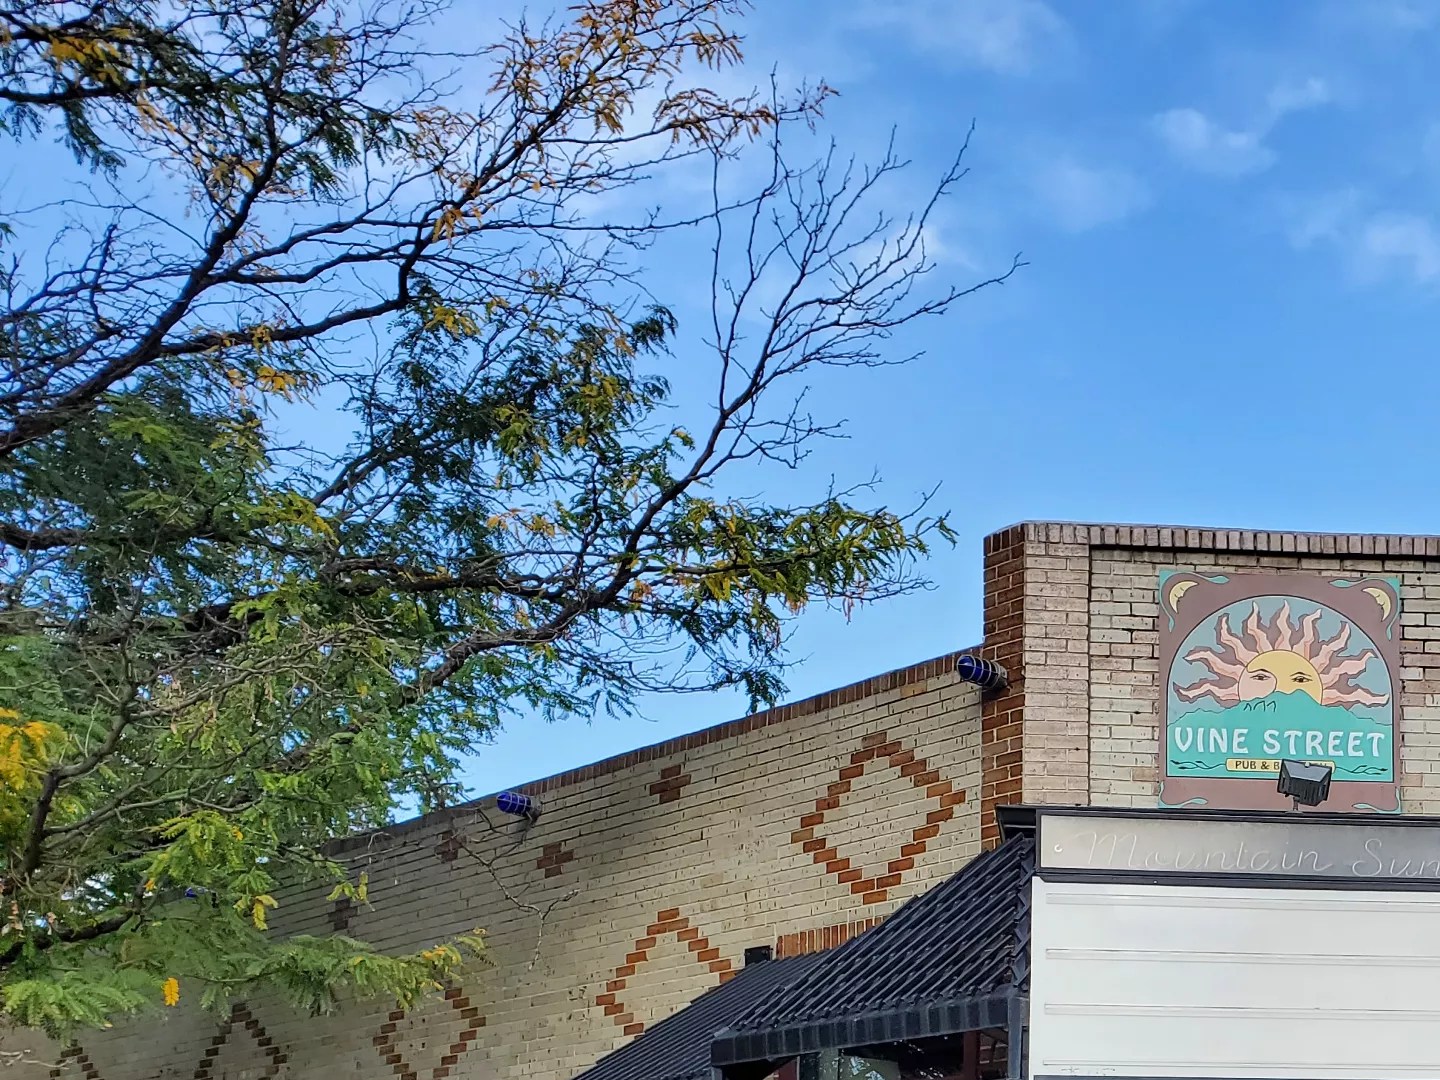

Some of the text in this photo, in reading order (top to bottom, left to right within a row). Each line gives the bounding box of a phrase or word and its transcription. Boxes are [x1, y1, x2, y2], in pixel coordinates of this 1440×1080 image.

[1174, 726, 1385, 757] VINE STREET
[1235, 760, 1257, 770] PUB
[1260, 761, 1270, 770] &
[1073, 831, 1333, 871] Mountain
